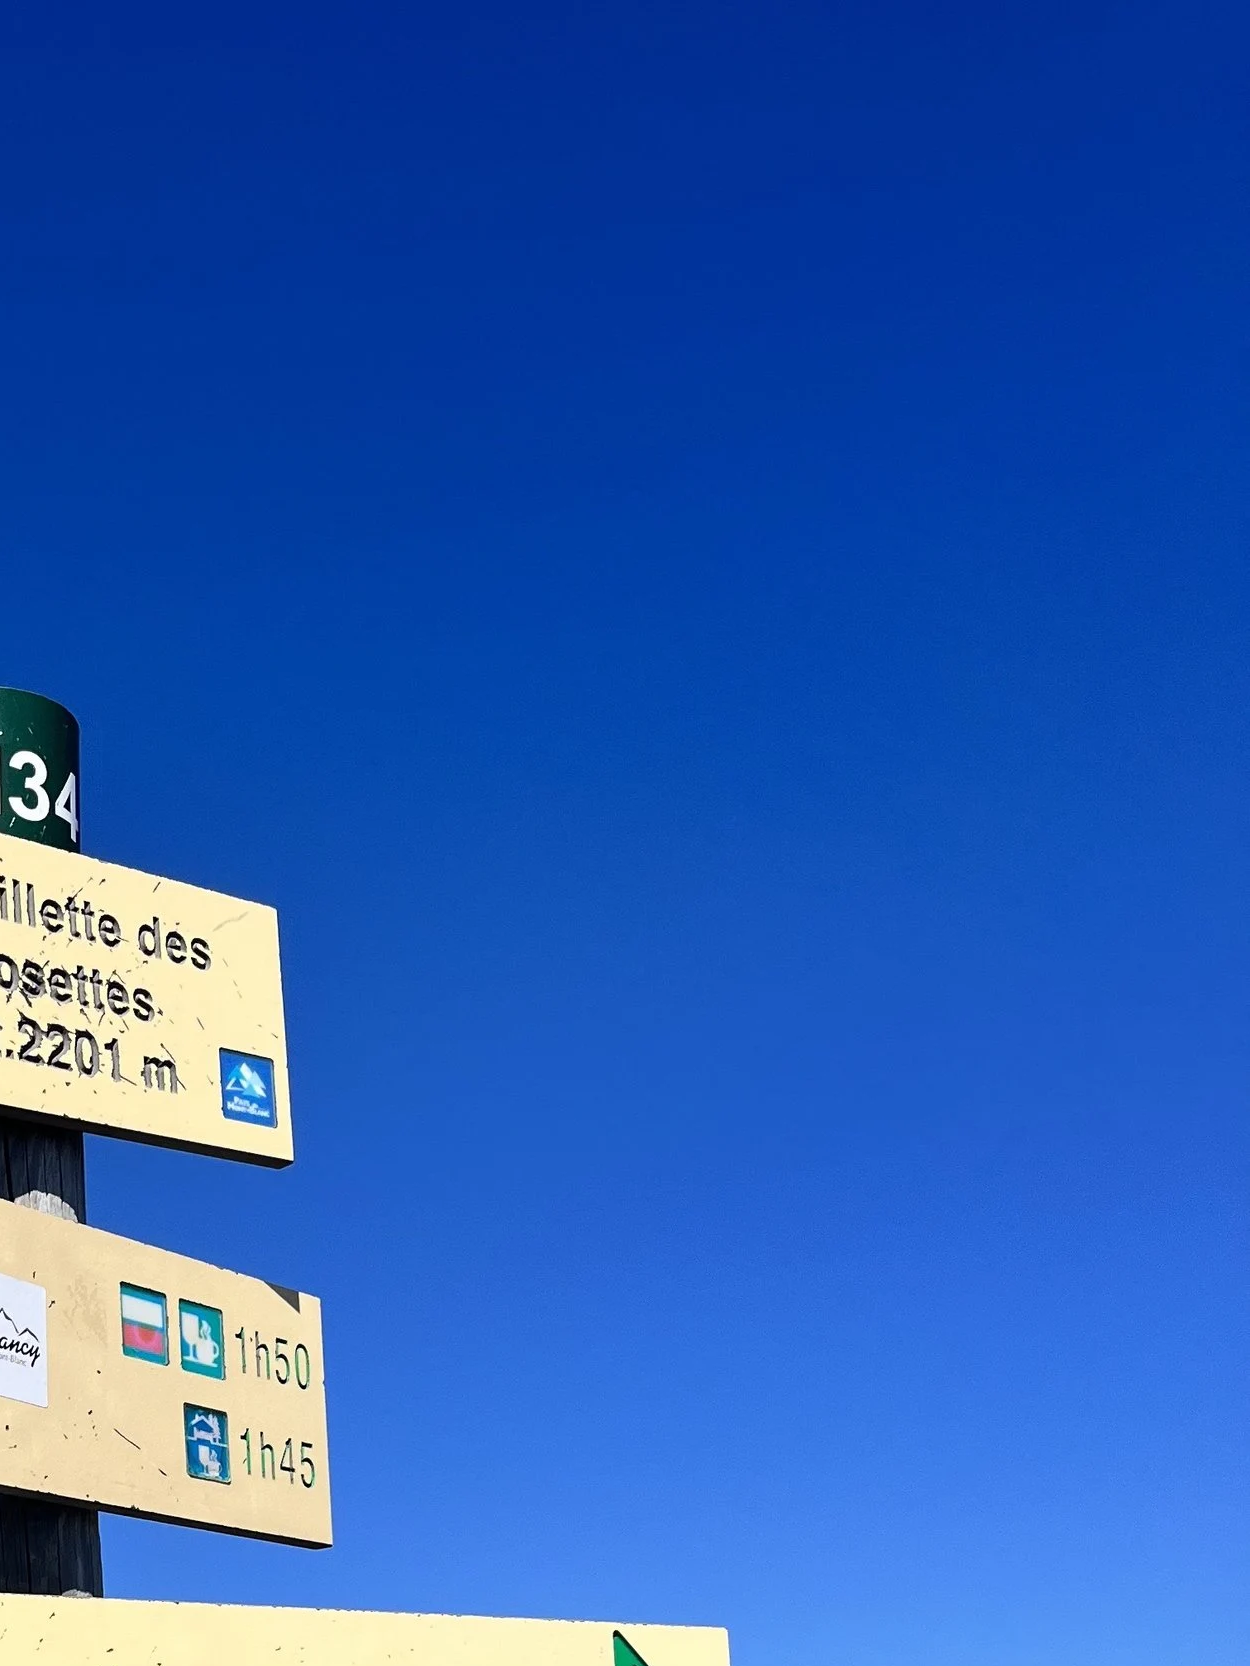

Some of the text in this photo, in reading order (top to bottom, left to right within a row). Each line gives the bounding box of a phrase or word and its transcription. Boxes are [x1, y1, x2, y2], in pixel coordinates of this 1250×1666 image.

[138, 916, 212, 971] des
[143, 1054, 178, 1093] m
[234, 1327, 311, 1390] 1h50
[240, 1428, 316, 1489] 1h45
